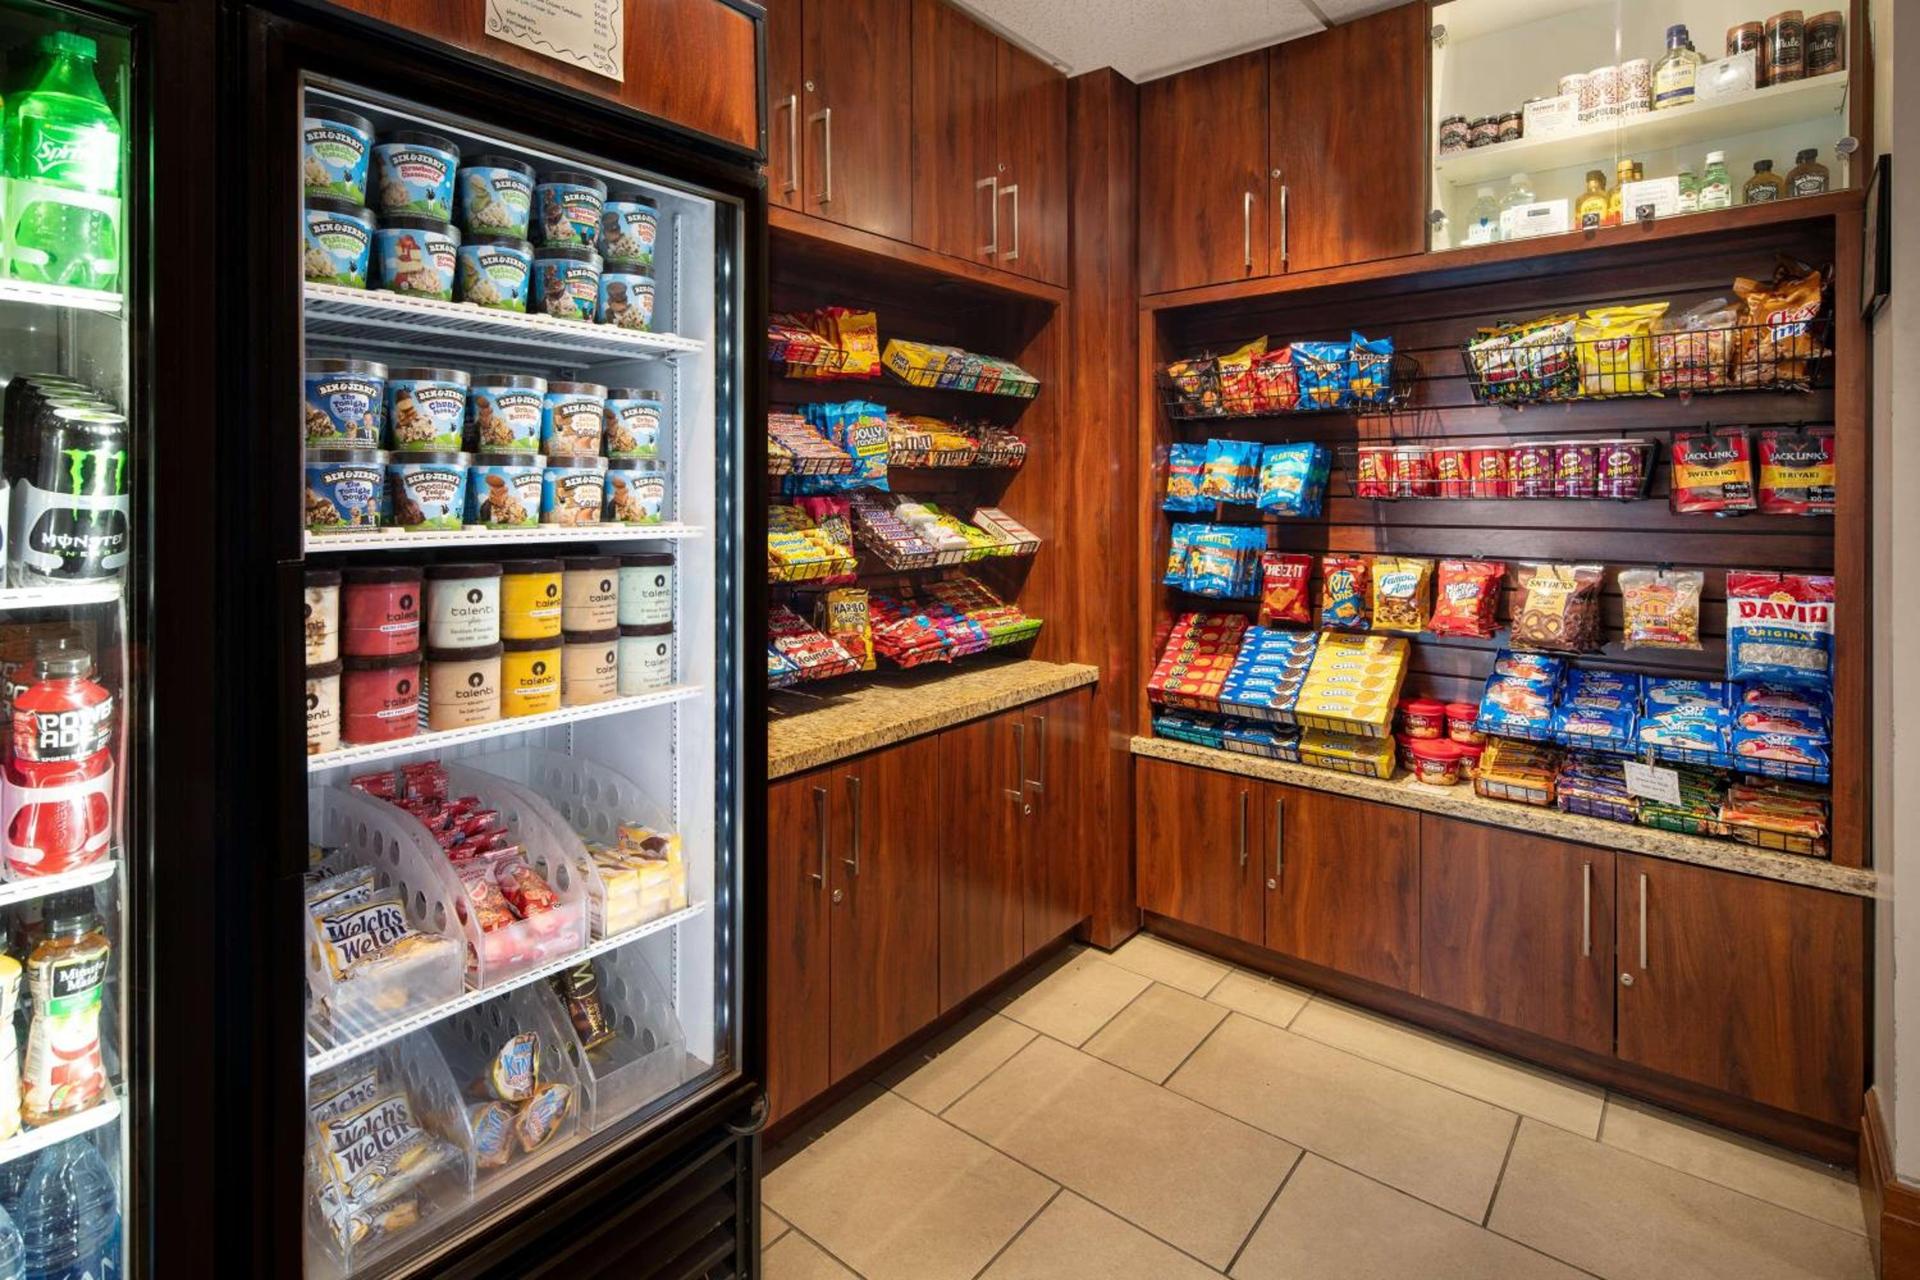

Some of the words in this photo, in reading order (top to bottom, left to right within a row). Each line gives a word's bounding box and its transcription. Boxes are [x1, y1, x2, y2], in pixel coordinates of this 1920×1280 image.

[1767, 304, 1818, 328] Chex
[854, 427, 882, 441] JOLLY
[1684, 452, 1707, 461] JACK
[1770, 453, 1795, 462] JACK
[41, 533, 124, 550] MONSTE
[450, 607, 494, 616] talenti
[1739, 601, 1827, 623] DAVID
[1748, 629, 1818, 641] ORIGINAL
[520, 676, 556, 686] talenti
[455, 688, 494, 699] talenti
[384, 695, 417, 708] talent
[326, 908, 403, 942] Welch's
[333, 1103, 408, 1152] Welch's
